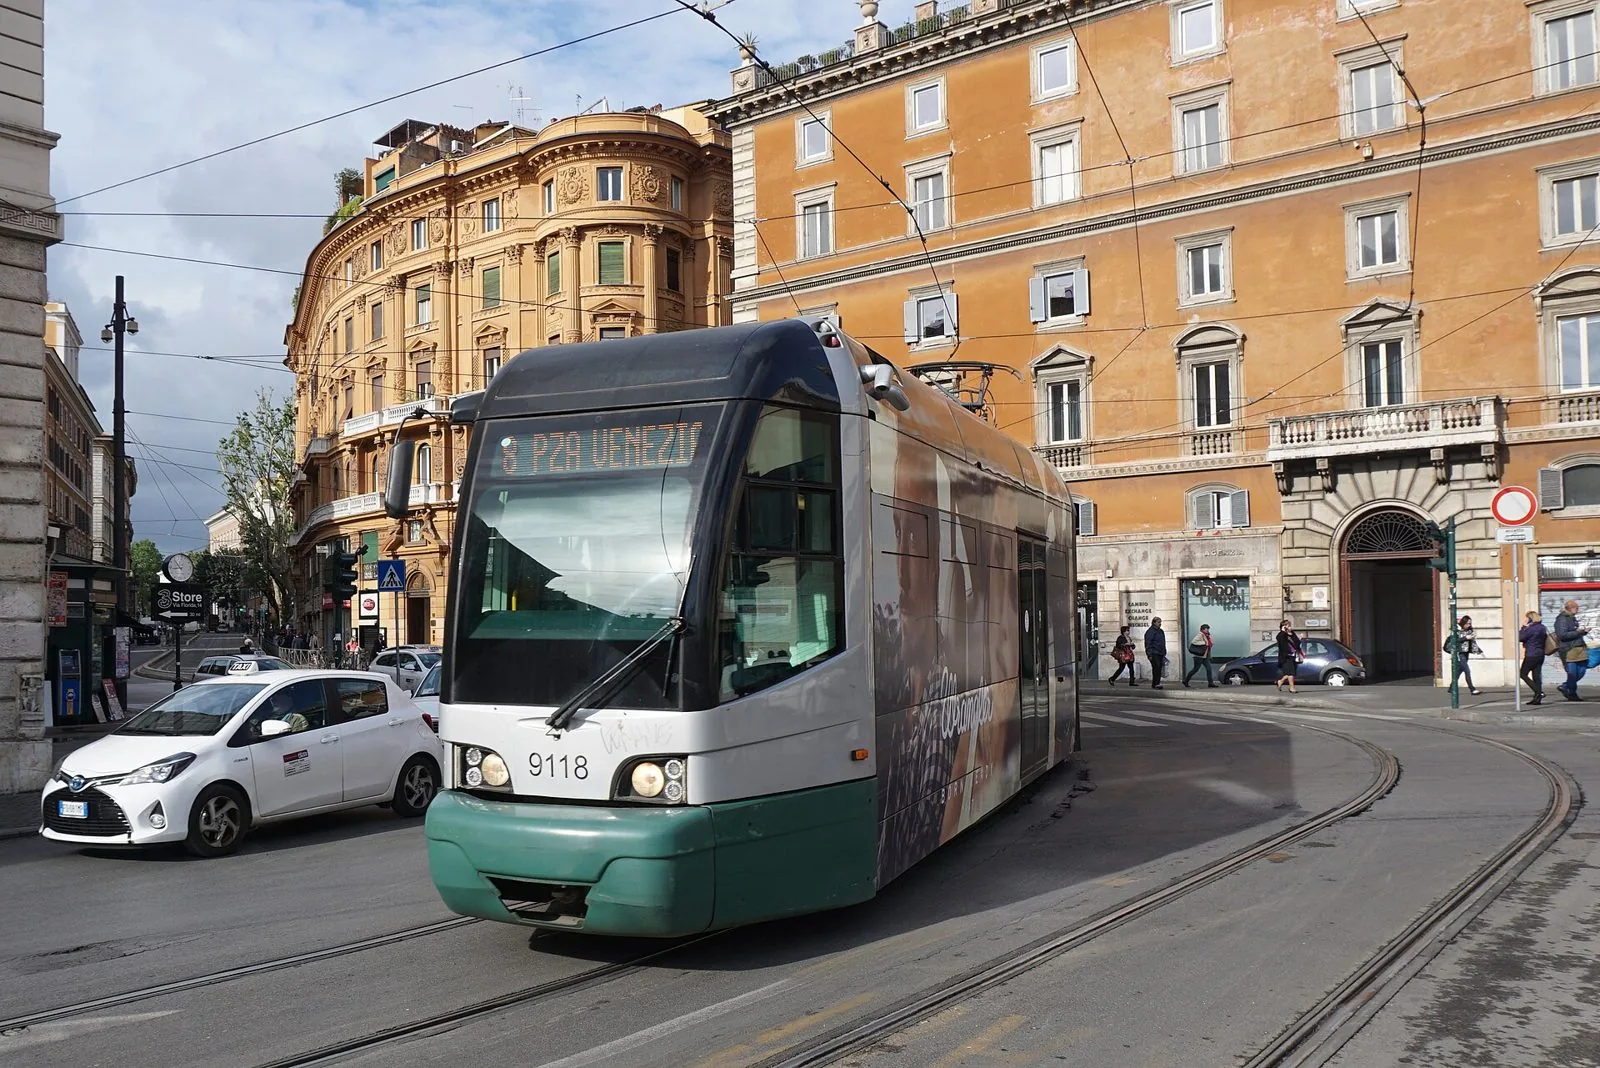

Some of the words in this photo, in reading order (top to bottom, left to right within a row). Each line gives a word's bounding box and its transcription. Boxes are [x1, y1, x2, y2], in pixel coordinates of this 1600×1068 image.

[503, 436, 518, 475] 8
[532, 431, 581, 472] PZA
[172, 591, 202, 602] Store
[940, 665, 993, 739] Wrangler
[528, 752, 588, 780] 9118
